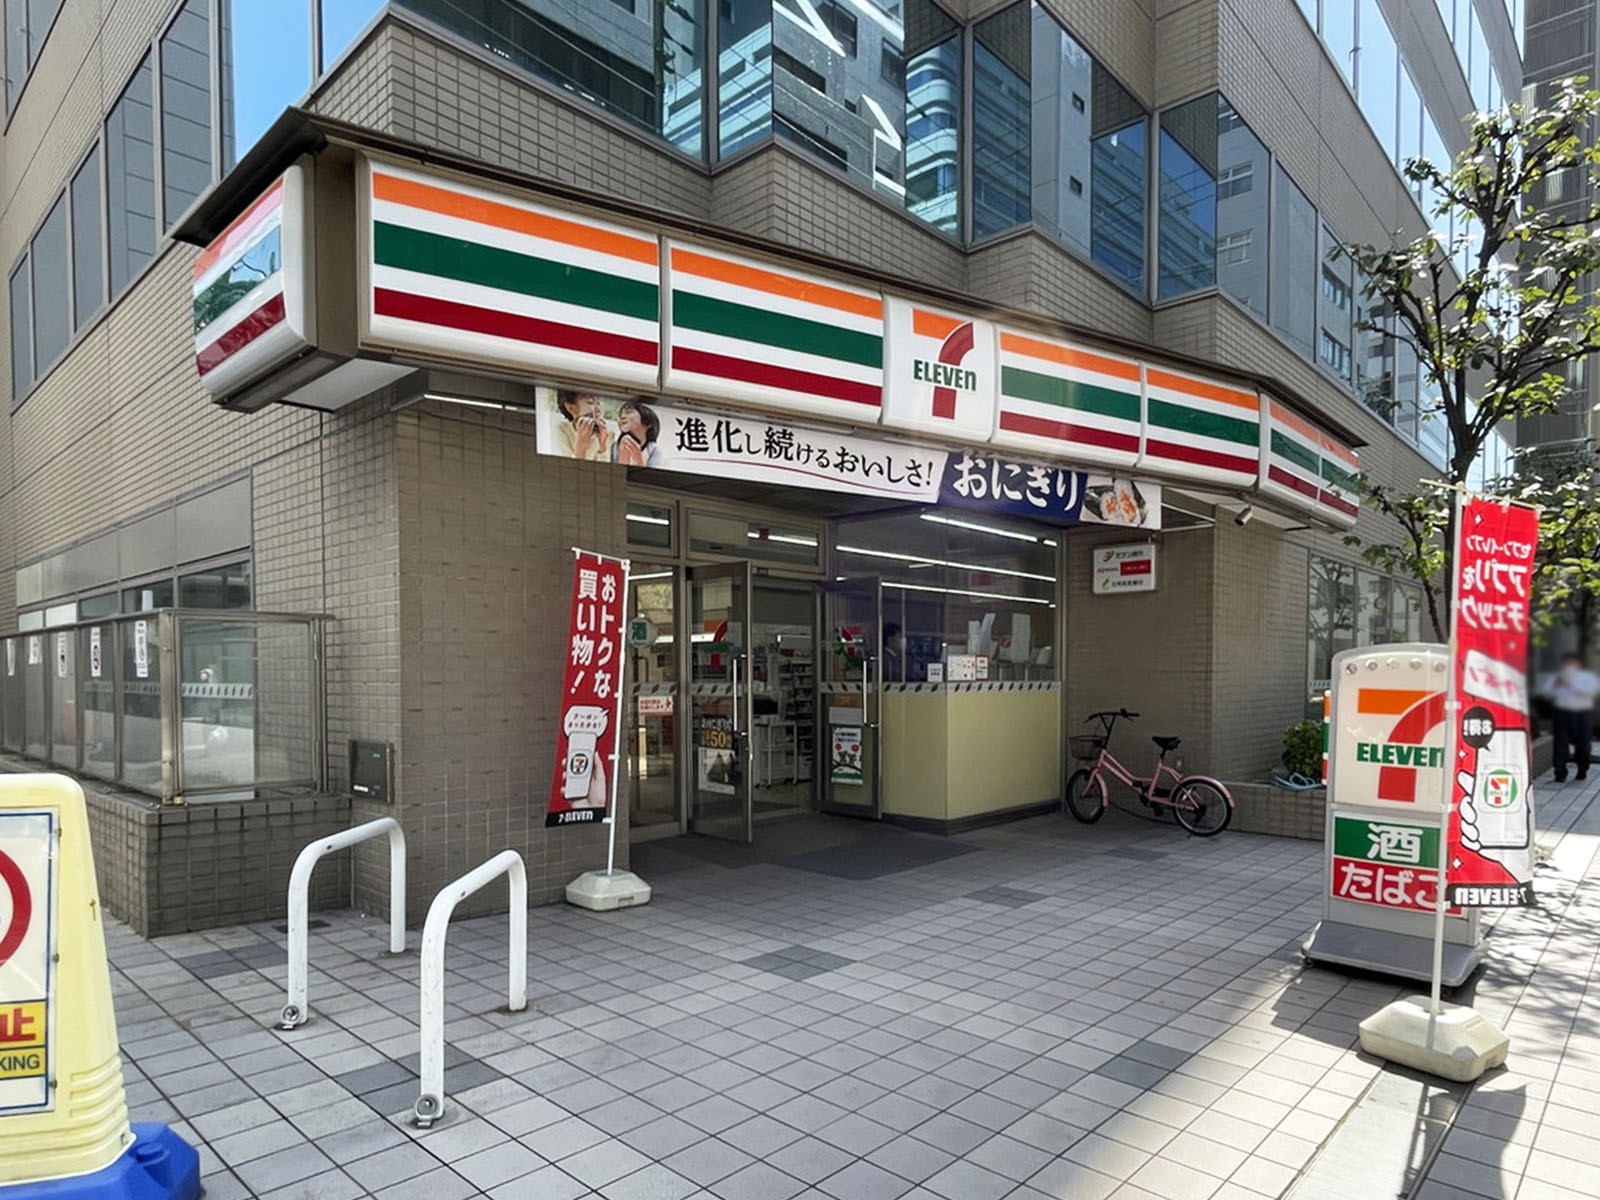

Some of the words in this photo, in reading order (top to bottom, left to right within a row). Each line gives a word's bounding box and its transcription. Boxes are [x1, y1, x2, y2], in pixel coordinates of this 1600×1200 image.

[675, 417, 934, 487] 進化し続けるおいしさ!
[953, 454, 1078, 511] おにぎり
[570, 569, 598, 695] 買い物!
[593, 574, 616, 699] おトクな
[1367, 823, 1424, 864] 酒
[1340, 863, 1448, 909] たばこ
